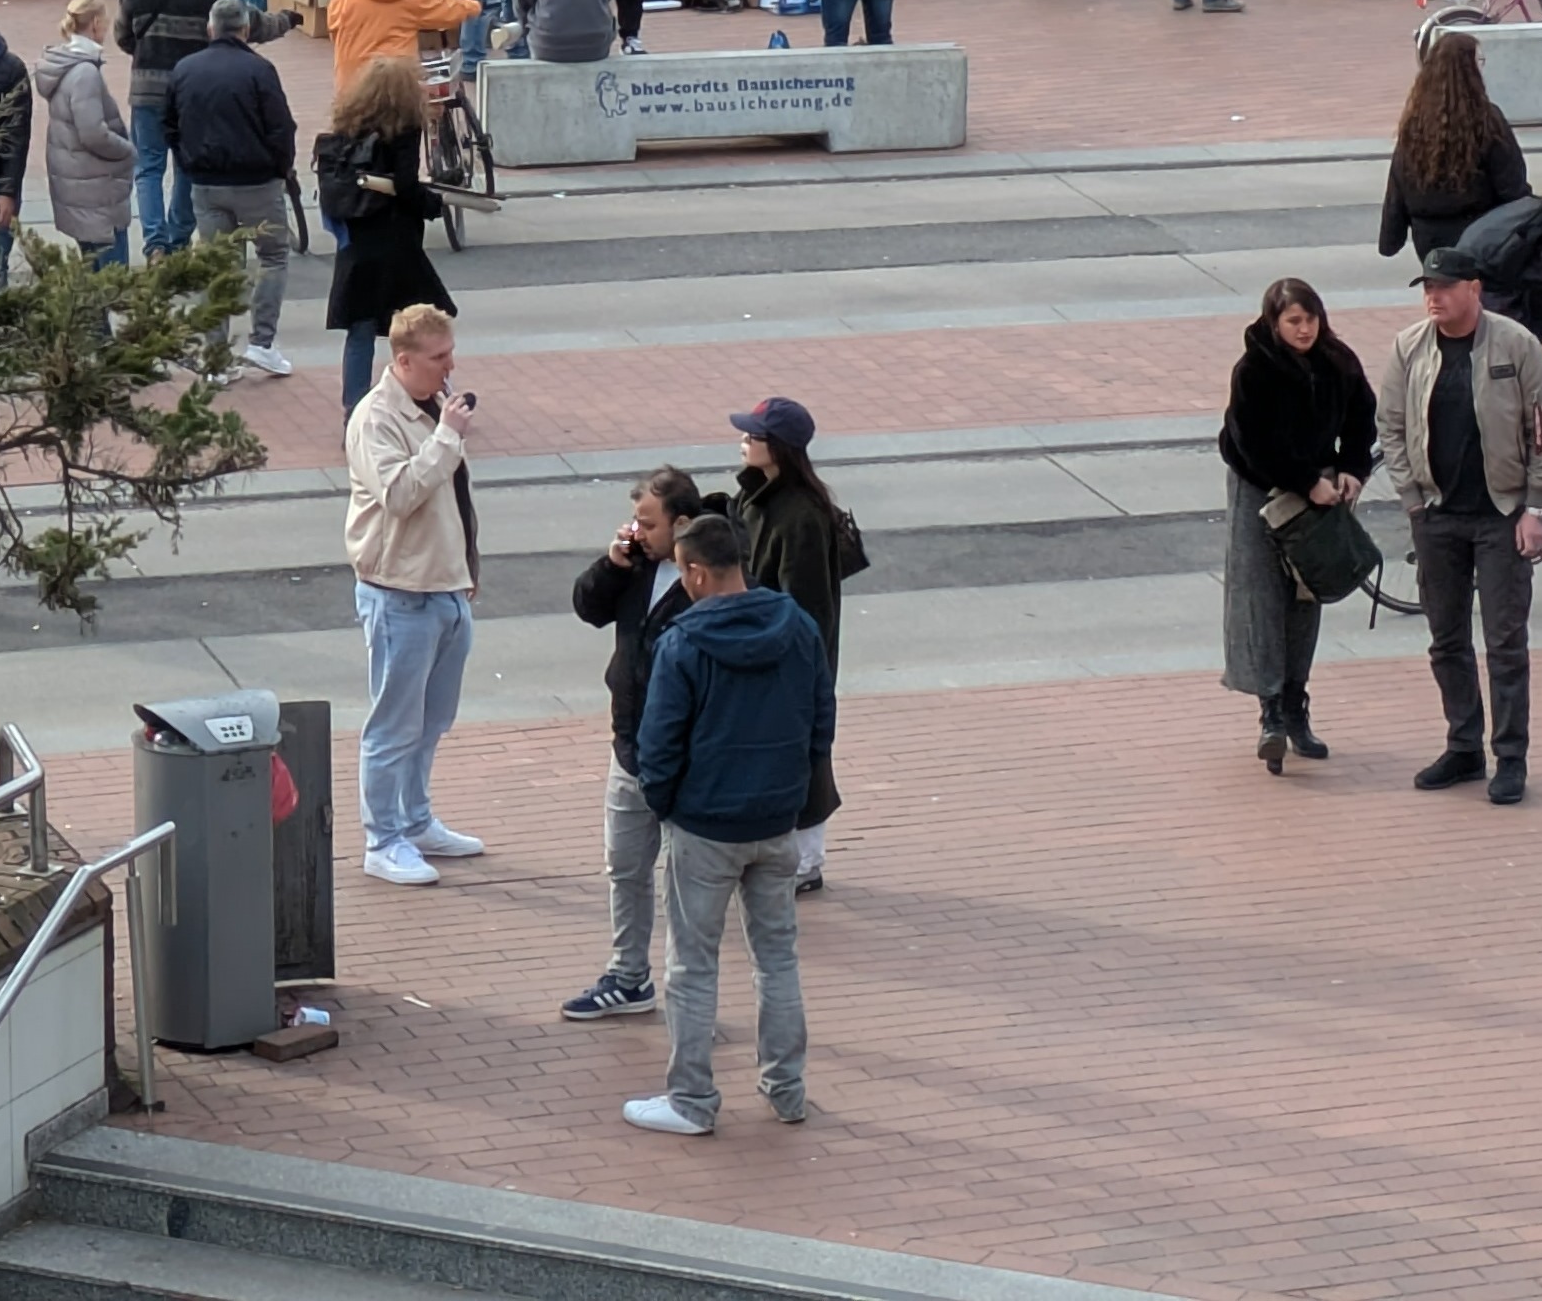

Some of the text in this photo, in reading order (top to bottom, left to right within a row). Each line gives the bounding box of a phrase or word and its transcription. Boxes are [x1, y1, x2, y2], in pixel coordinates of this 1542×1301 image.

[630, 75, 856, 96] bhd-cordts Bausicherung
[639, 92, 854, 115] www.bausicherung.de
